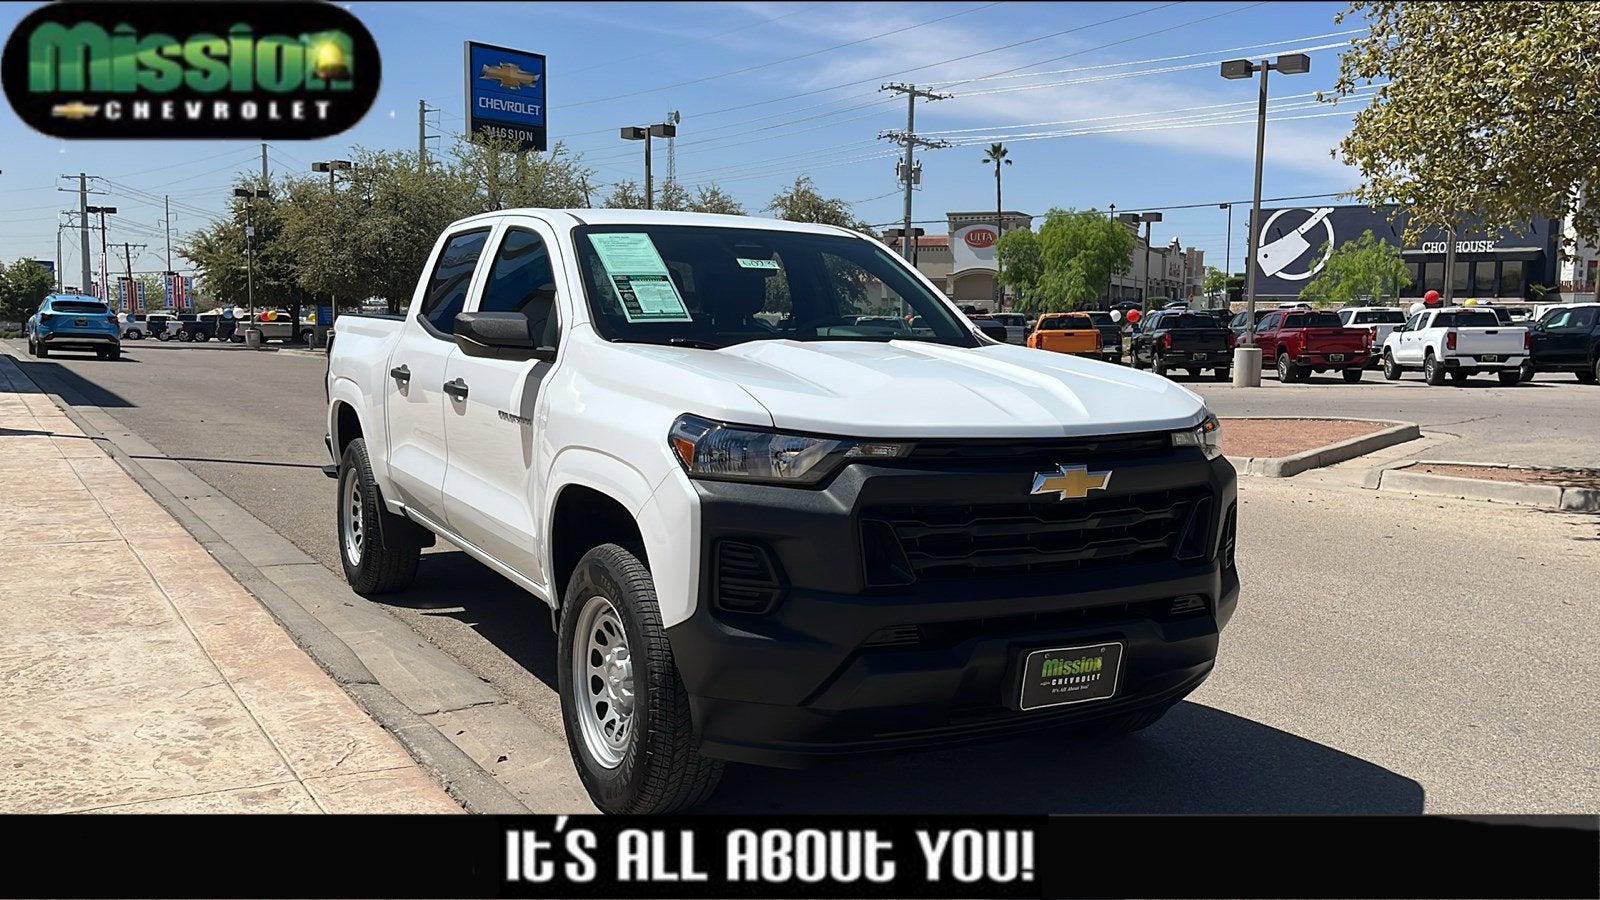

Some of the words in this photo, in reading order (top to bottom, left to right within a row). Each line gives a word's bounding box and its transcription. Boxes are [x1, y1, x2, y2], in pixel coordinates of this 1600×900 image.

[478, 96, 541, 116] CHEVROLET
[1422, 240, 1495, 253] CHOHOUSE
[1041, 656, 1103, 678] Mission
[1051, 673, 1101, 686] CHEVROLET
